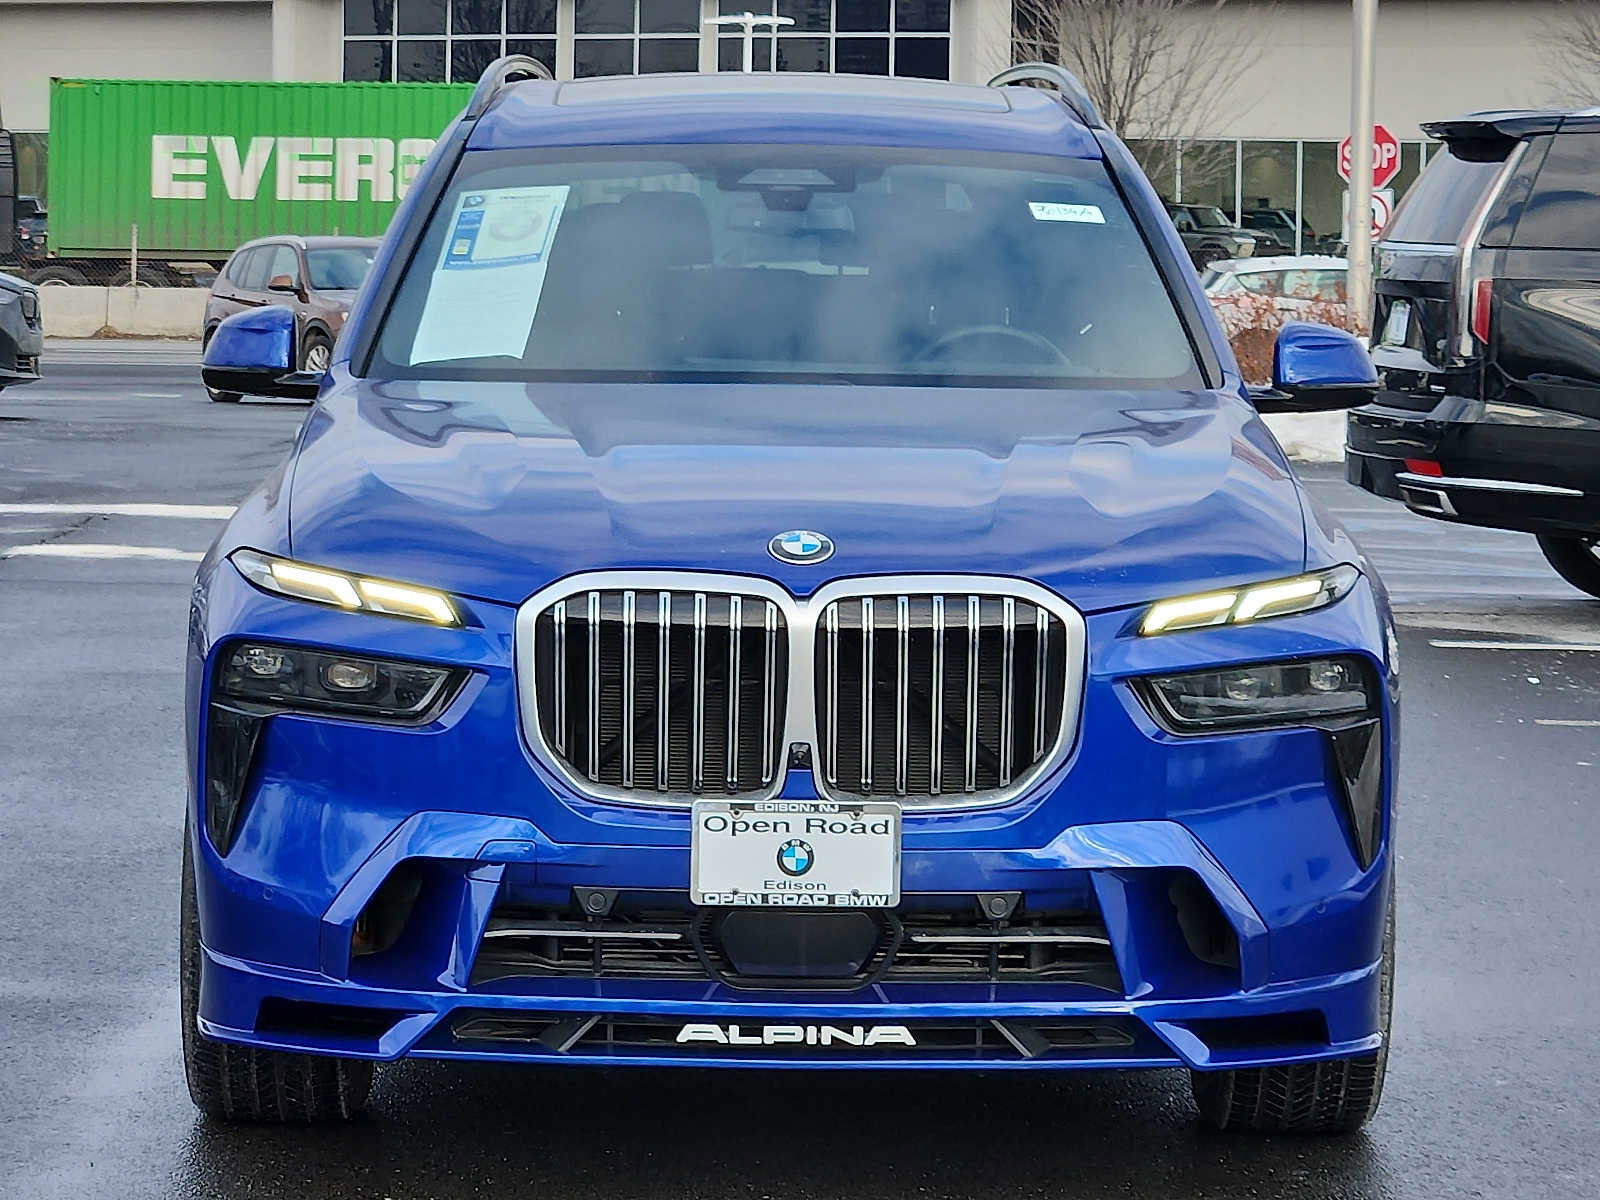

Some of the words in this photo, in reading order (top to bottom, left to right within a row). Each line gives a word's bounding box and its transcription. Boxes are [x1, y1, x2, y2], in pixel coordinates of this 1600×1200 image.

[1342, 143, 1396, 169] SOP
[818, 804, 840, 813] NJ
[703, 815, 791, 836] Open
[805, 818, 889, 835] Road
[781, 839, 812, 852] BMW
[763, 880, 827, 891] Edison
[703, 893, 762, 905] OPEN
[767, 893, 829, 905] ROAD
[834, 894, 887, 907] BMW
[675, 1023, 917, 1046] ALPINA
